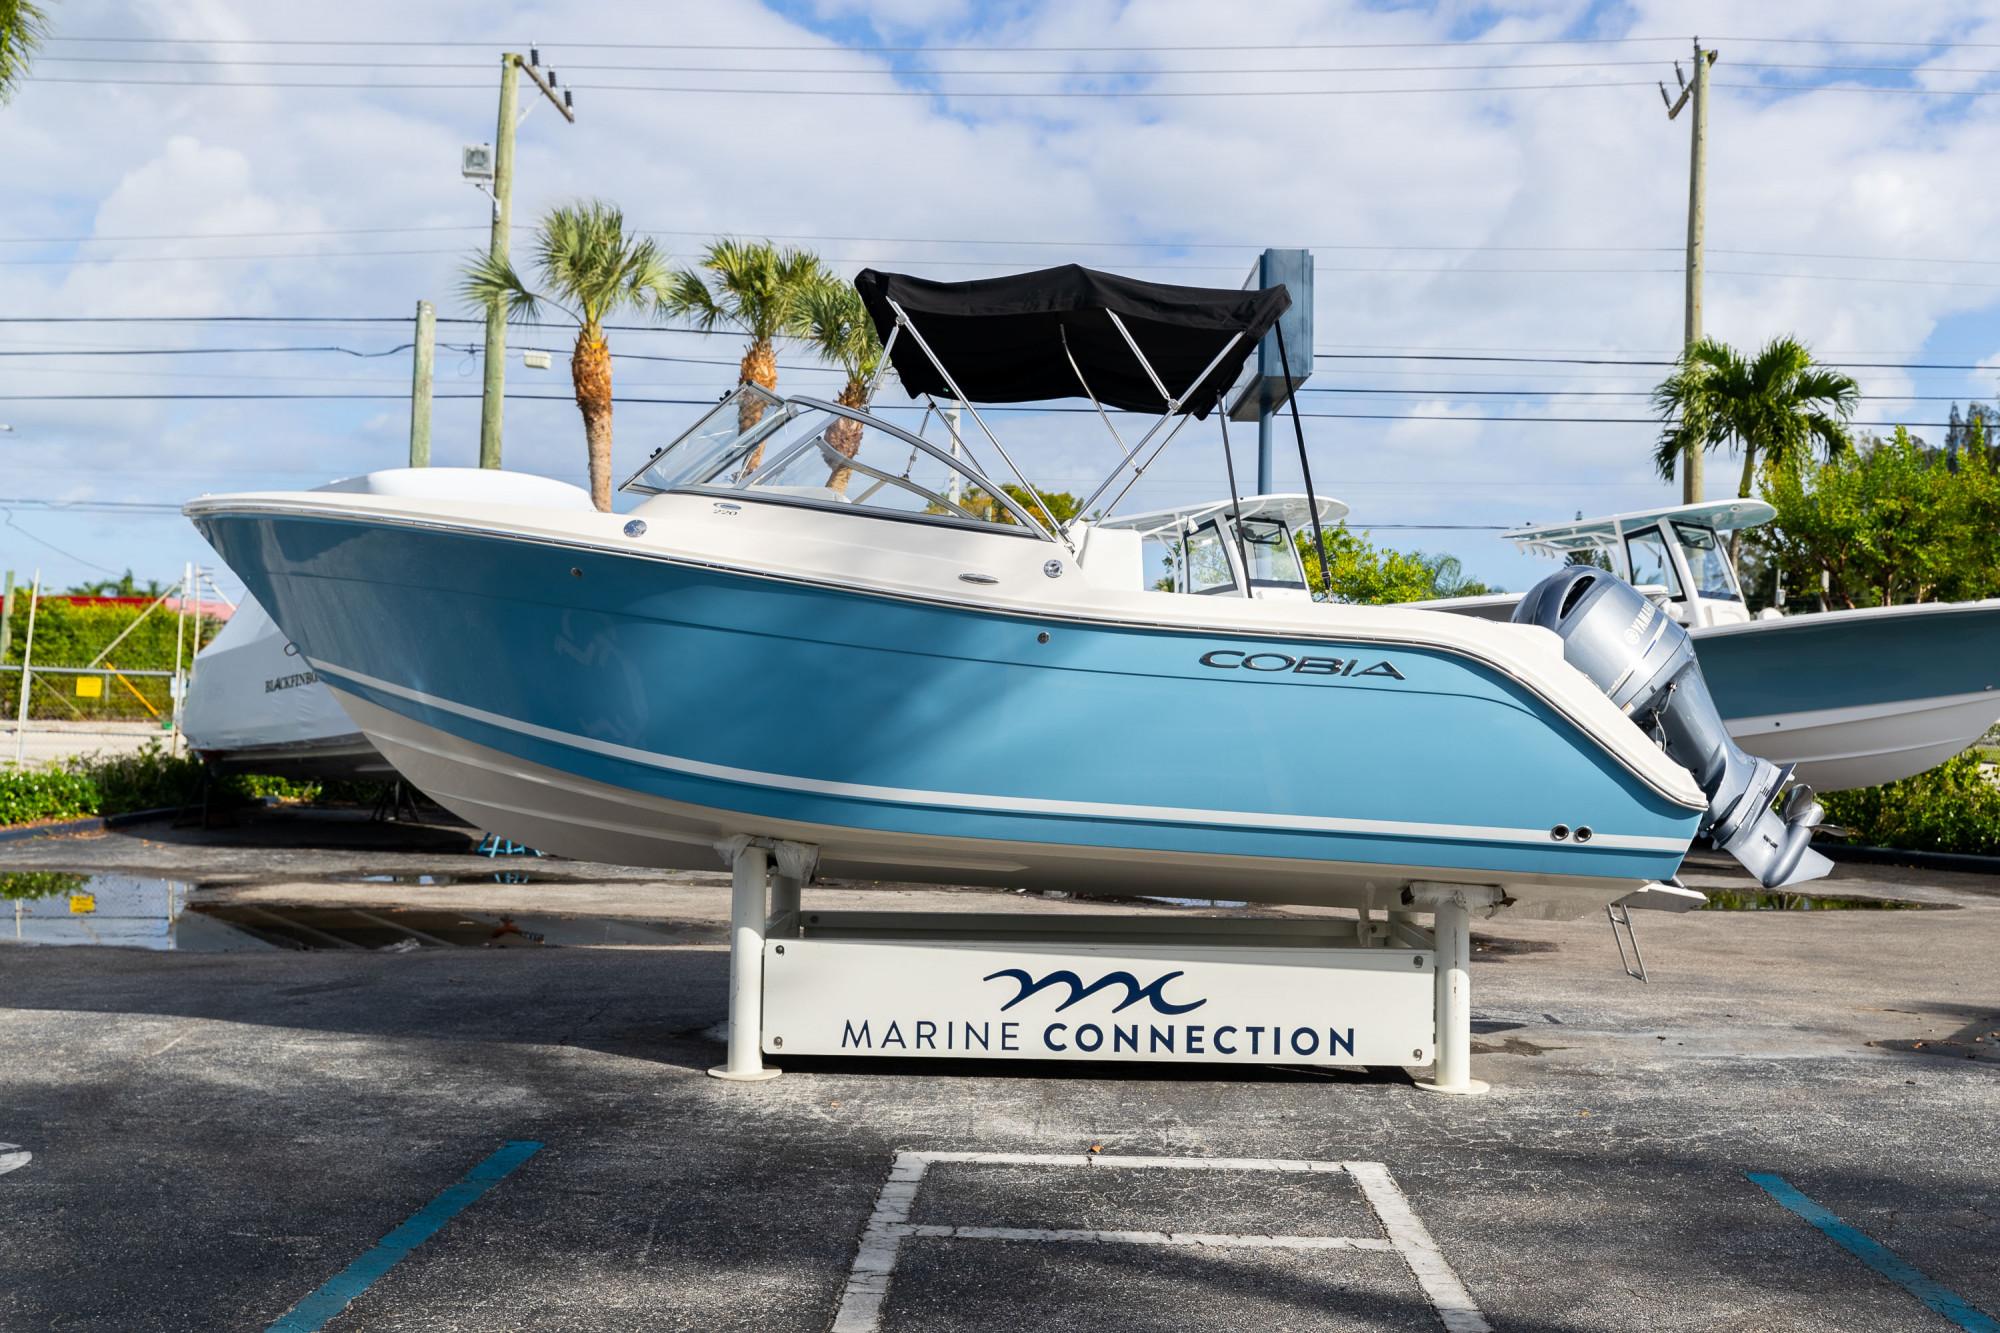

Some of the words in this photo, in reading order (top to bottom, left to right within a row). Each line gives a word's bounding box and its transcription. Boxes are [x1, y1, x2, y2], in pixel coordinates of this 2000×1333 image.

[1199, 650, 1406, 681] COBIA
[841, 1019, 1020, 1051] MARINE
[1043, 1022, 1355, 1057] CONNECTION
